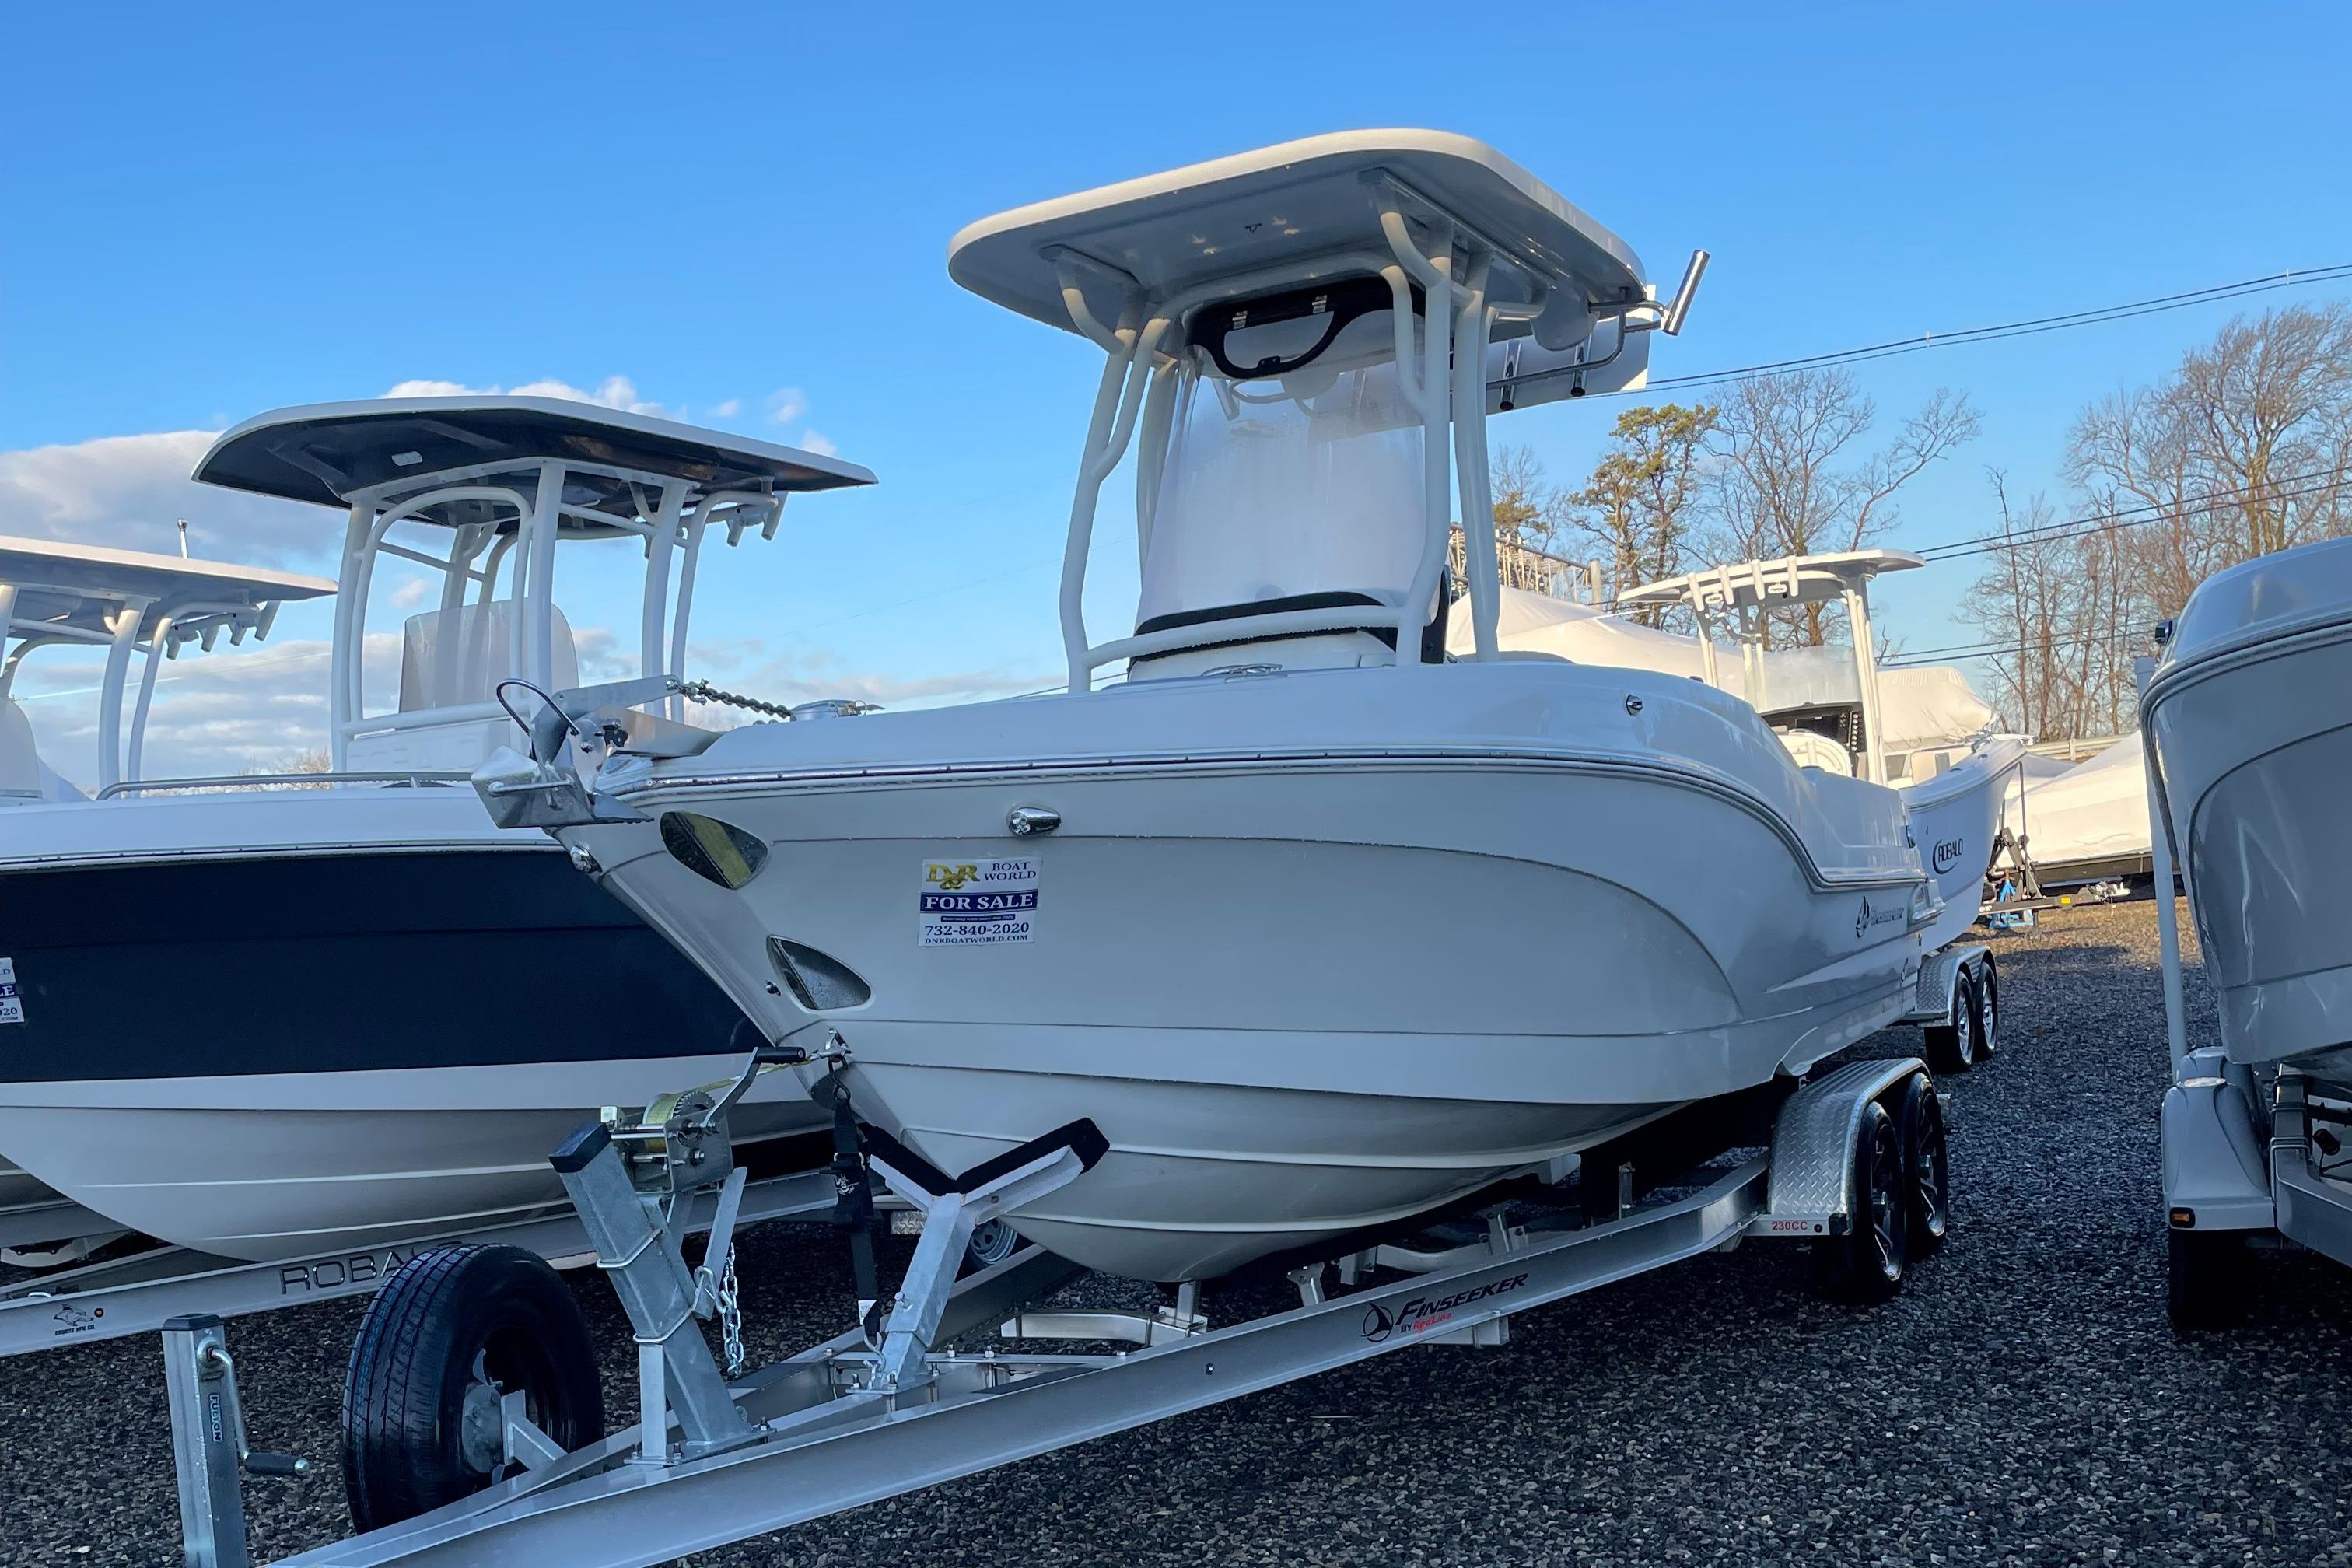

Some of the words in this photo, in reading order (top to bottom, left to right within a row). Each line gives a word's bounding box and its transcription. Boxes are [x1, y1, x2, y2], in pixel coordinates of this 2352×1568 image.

[992, 862, 1031, 871] BOAT
[984, 870, 1037, 881] WORLD
[924, 896, 971, 910] FOR
[976, 894, 1033, 910] SALE
[925, 922, 1029, 936] 732-840-2020
[925, 935, 1027, 944] DNRBOATWORLD.COM
[1772, 1221, 1808, 1230] 230CC
[1401, 1323, 1412, 1333] BY
